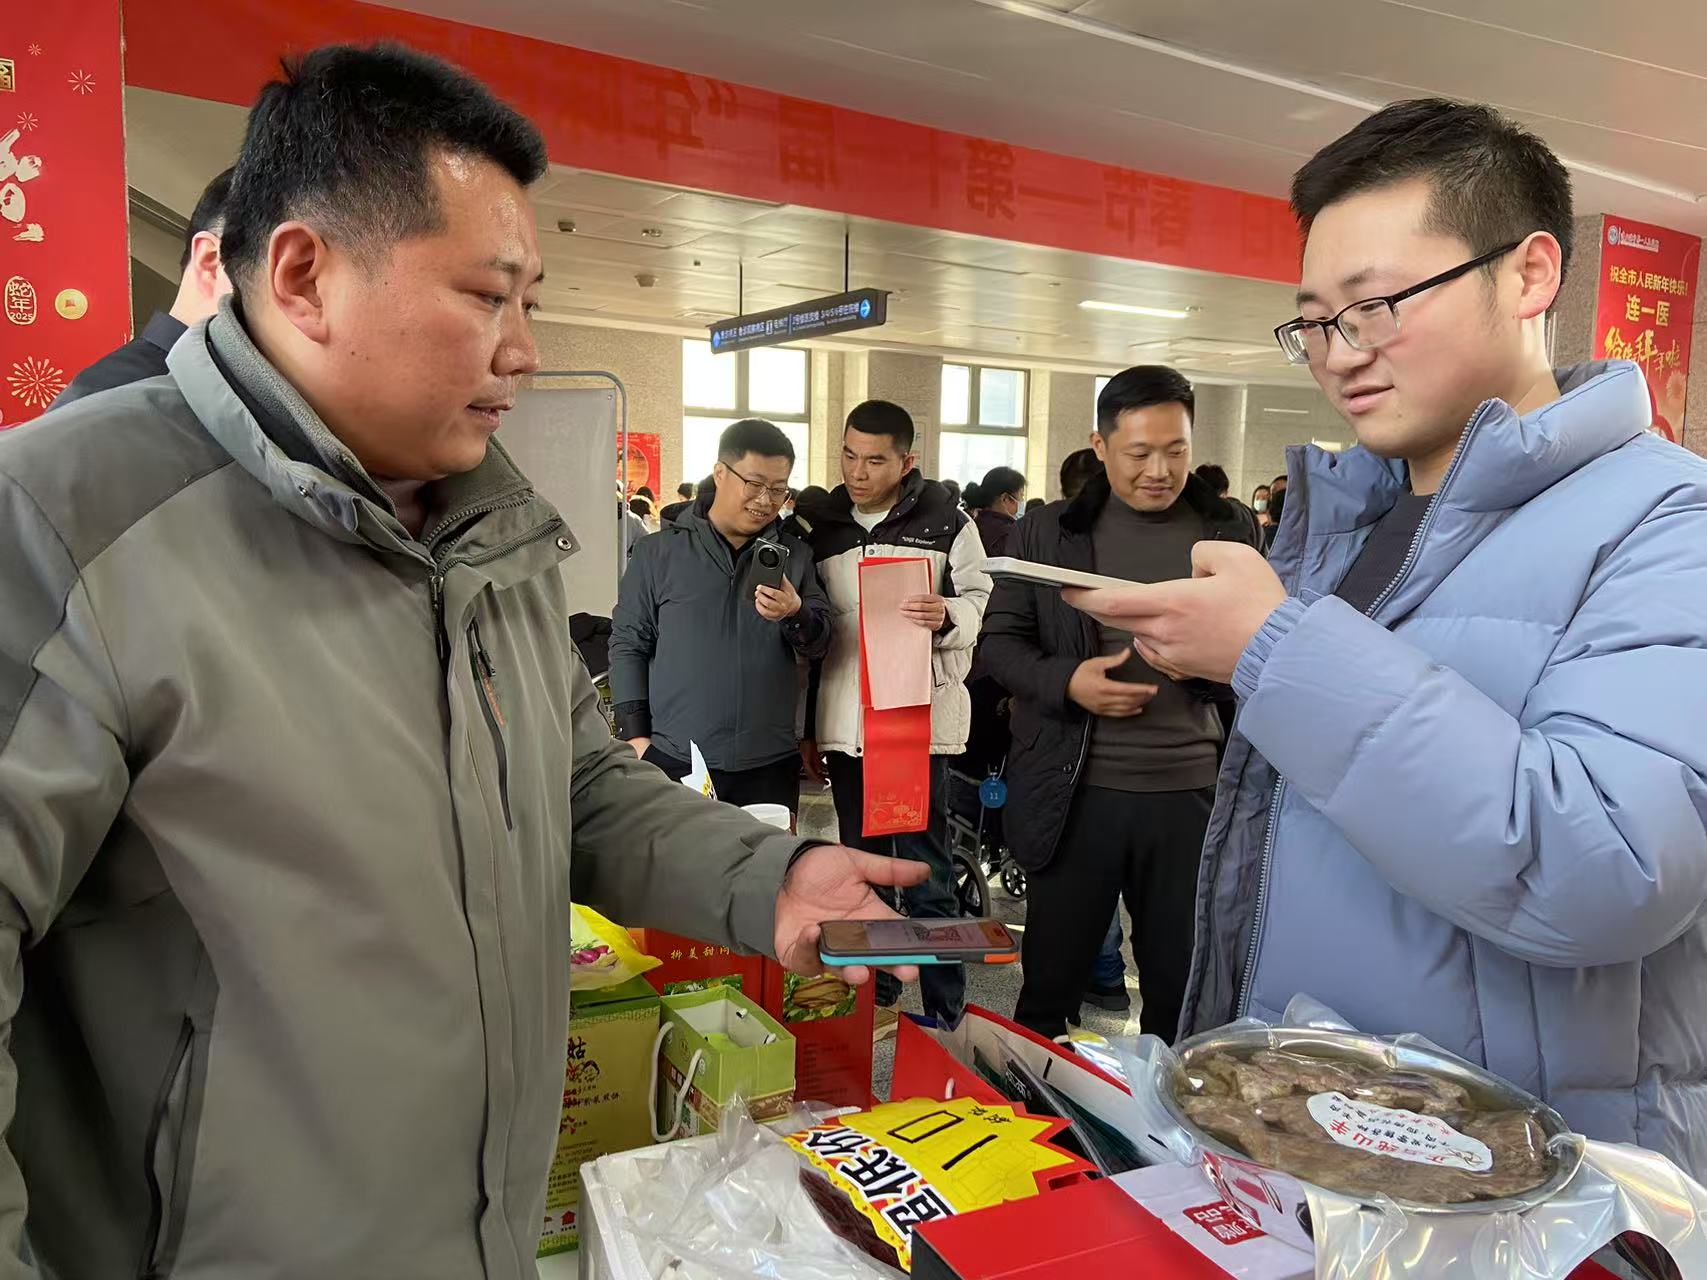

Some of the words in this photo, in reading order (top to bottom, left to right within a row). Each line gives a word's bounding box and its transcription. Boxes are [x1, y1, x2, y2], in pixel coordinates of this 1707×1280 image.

[9, 281, 33, 313] 蛇年
[1625, 293, 1671, 327] 连一医
[10, 312, 33, 321] 2025
